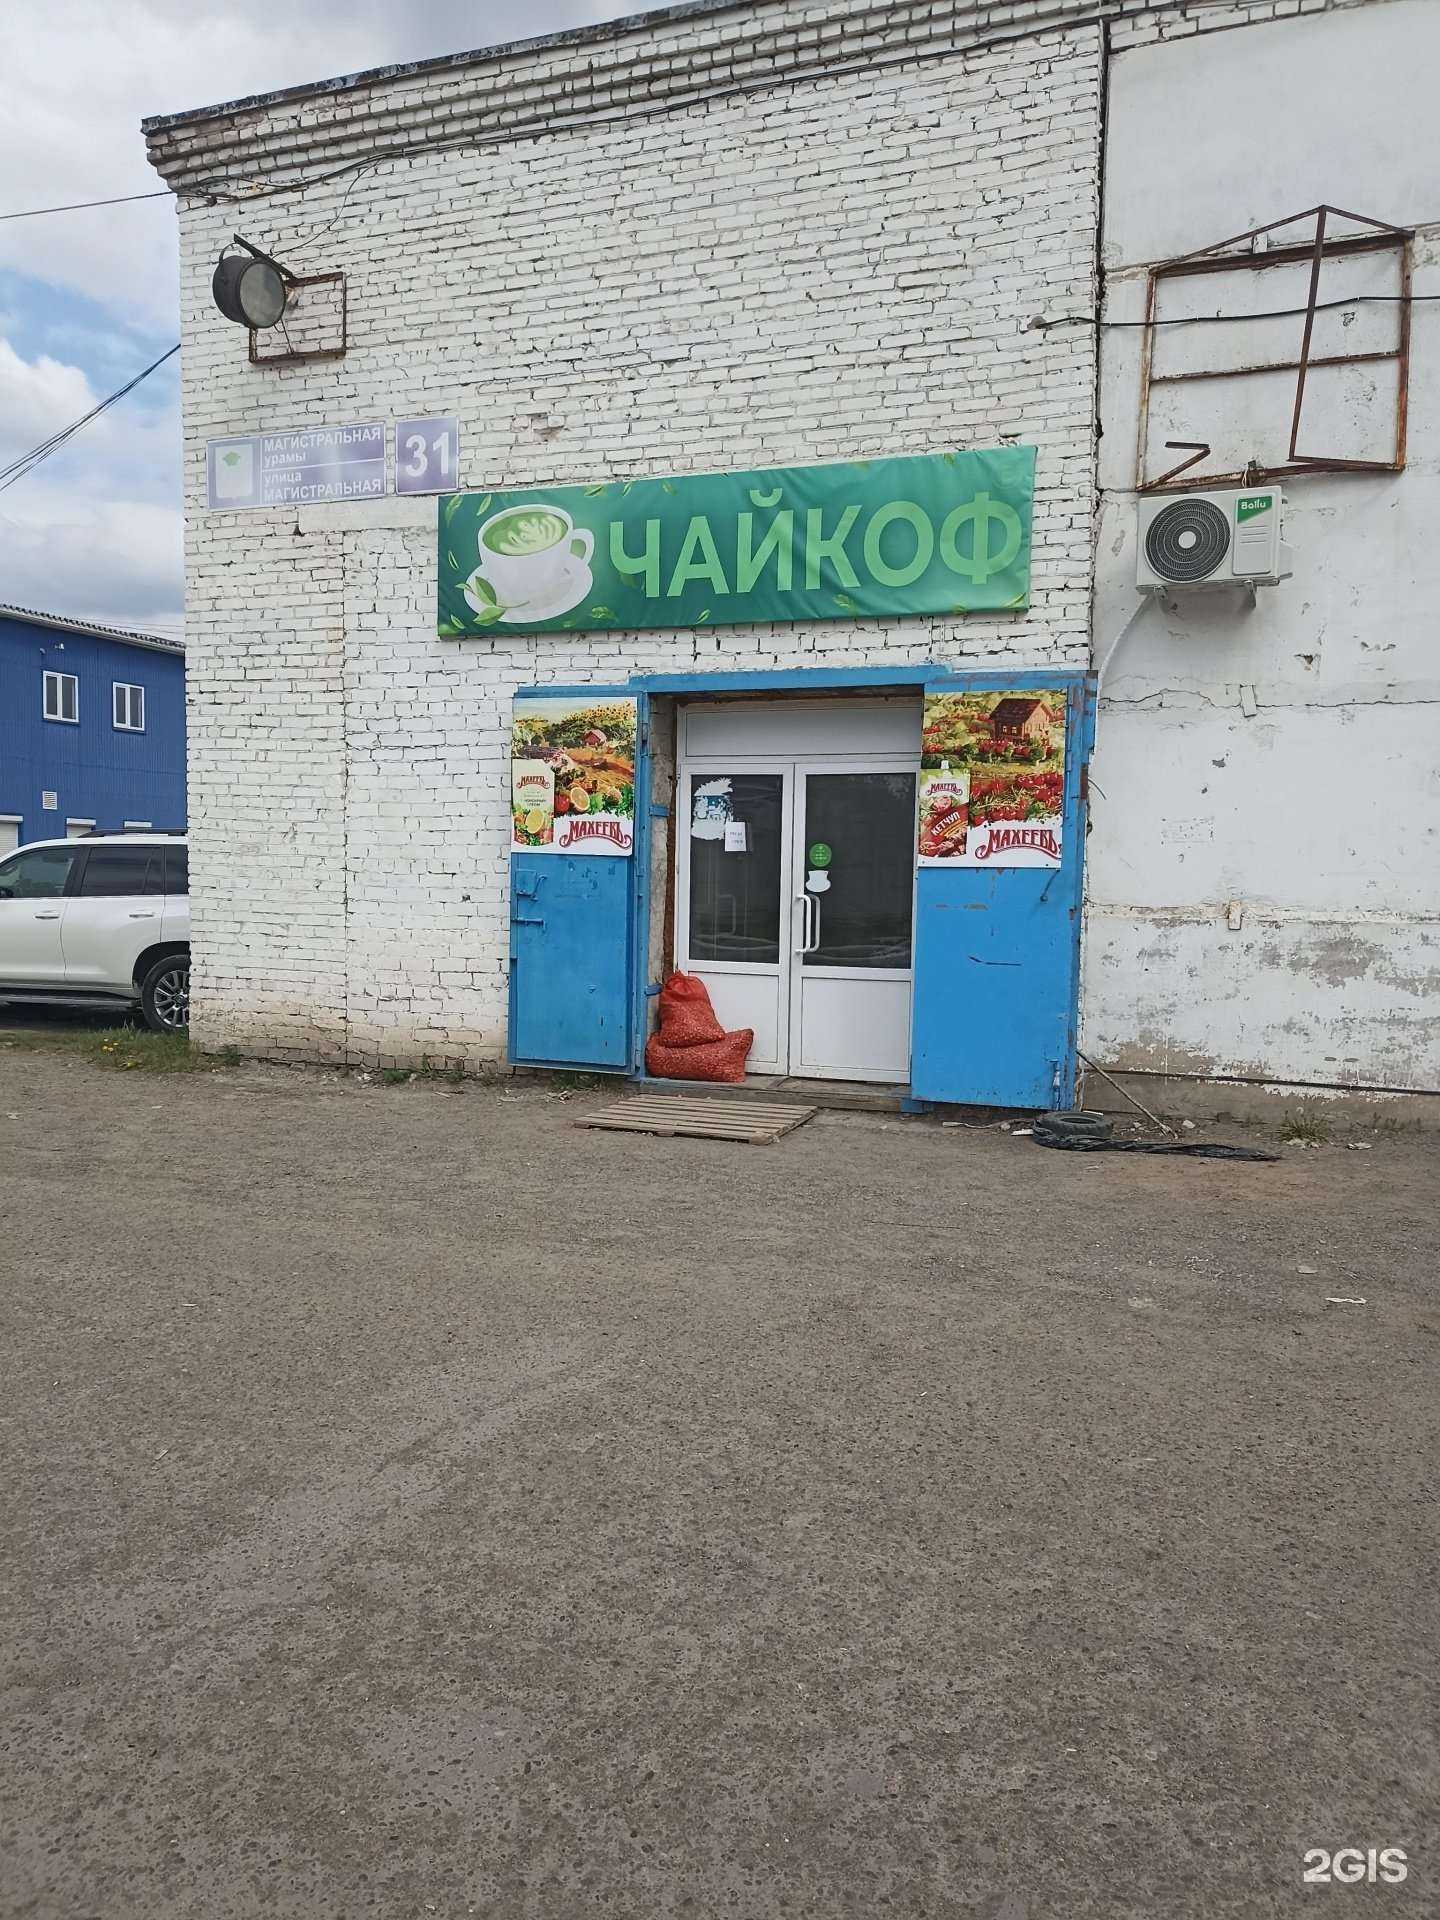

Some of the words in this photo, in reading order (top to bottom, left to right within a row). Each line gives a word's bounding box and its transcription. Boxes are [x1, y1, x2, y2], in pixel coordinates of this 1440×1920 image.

[264, 427, 381, 452] МАГИСТРАЛЬНАЯ
[264, 452, 306, 468] урамы
[405, 431, 449, 478] 31
[264, 472, 302, 486] улица
[264, 478, 381, 502] МАГИСТРАЛЬНАЯ
[609, 486, 1022, 599] ЧАЙКОФ
[931, 811, 960, 836] КЕТЧУП
